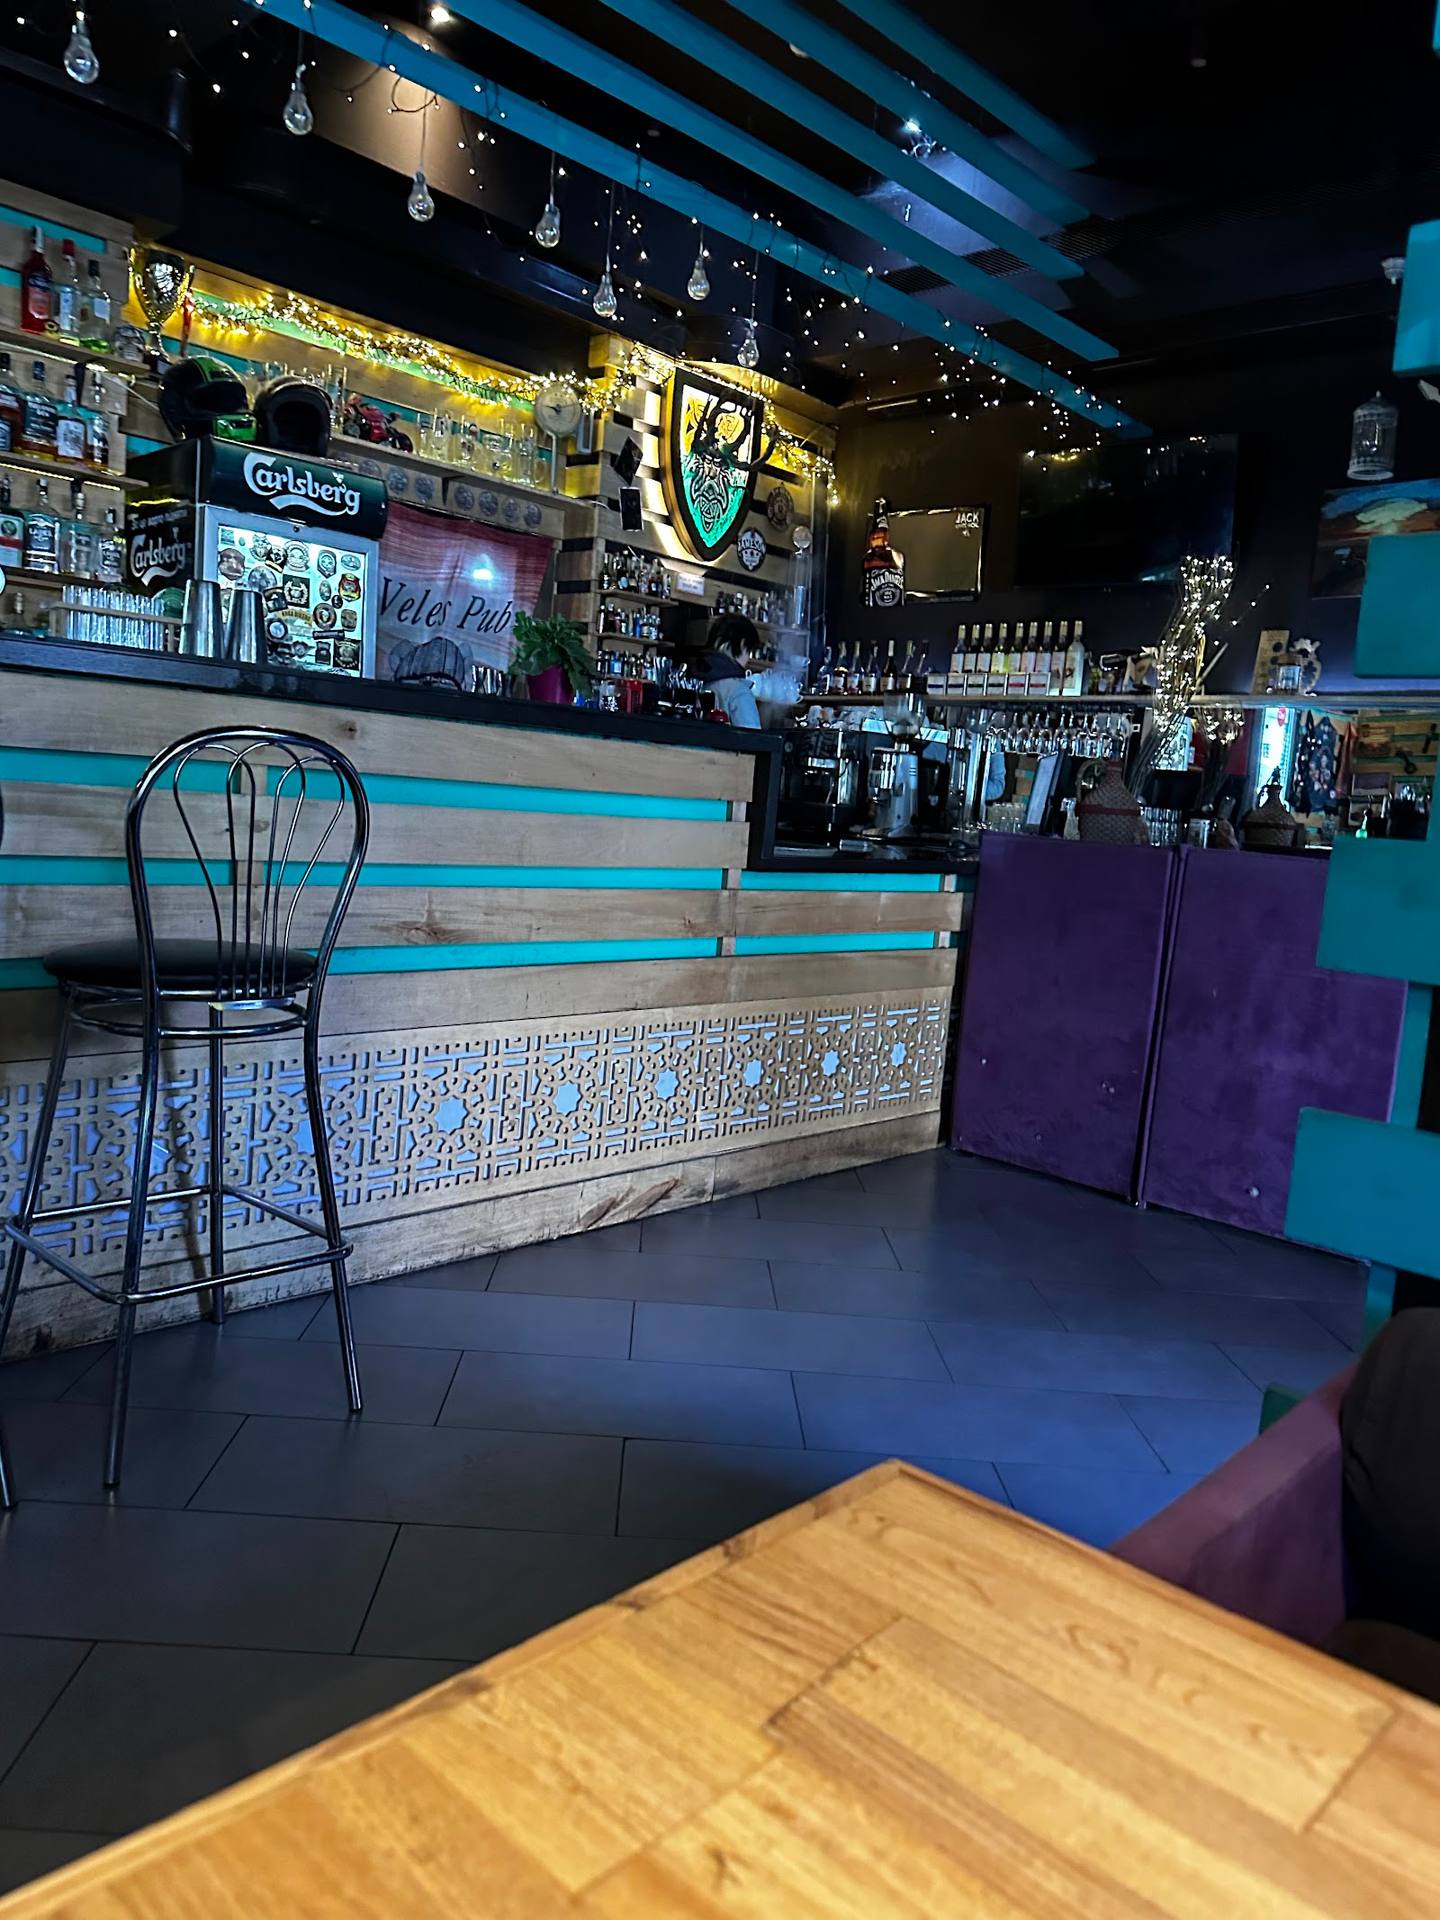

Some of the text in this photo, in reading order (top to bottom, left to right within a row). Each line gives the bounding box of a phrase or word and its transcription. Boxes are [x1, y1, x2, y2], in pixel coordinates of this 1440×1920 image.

[243, 452, 360, 516] Carlsberg
[955, 512, 980, 524] JACK
[130, 533, 186, 581] Carlsberg
[380, 576, 513, 634] Veles Pub
